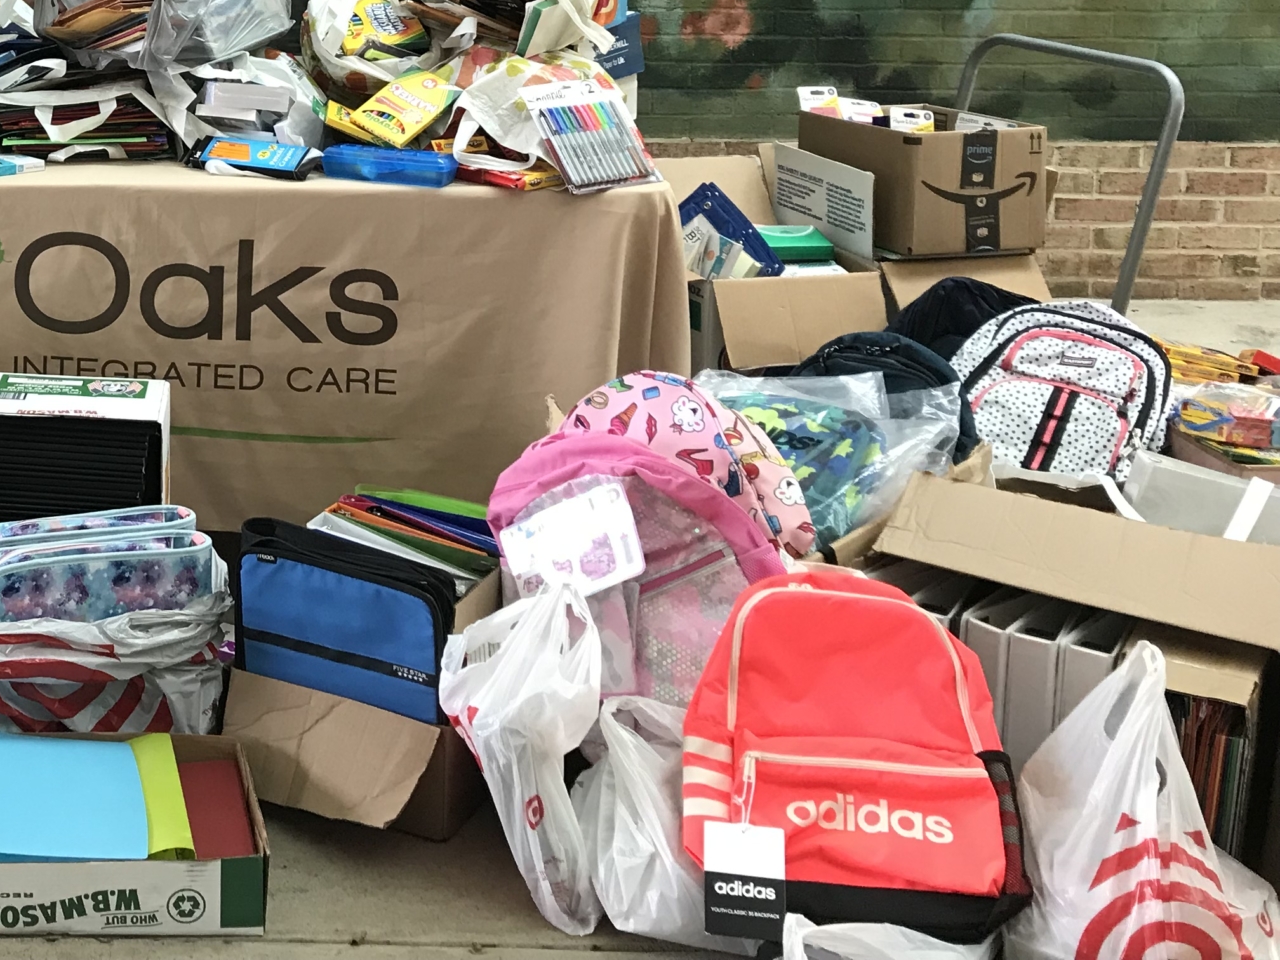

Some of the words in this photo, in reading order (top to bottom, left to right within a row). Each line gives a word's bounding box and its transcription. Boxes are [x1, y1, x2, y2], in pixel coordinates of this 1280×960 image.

[389, 83, 439, 113] MARKERS
[365, 110, 401, 135] Crayola
[966, 144, 993, 155] prime
[14, 231, 400, 346] Oaks
[12, 355, 265, 391] INTEGRATED
[285, 366, 398, 395] CARE
[392, 664, 409, 674] FIVE
[785, 792, 954, 844] adidas
[713, 879, 777, 901] adidas
[104, 913, 130, 926] BUT
[131, 912, 159, 925] WHO
[728, 908, 748, 916] CLASSIC
[754, 911, 780, 920] BACKPACK
